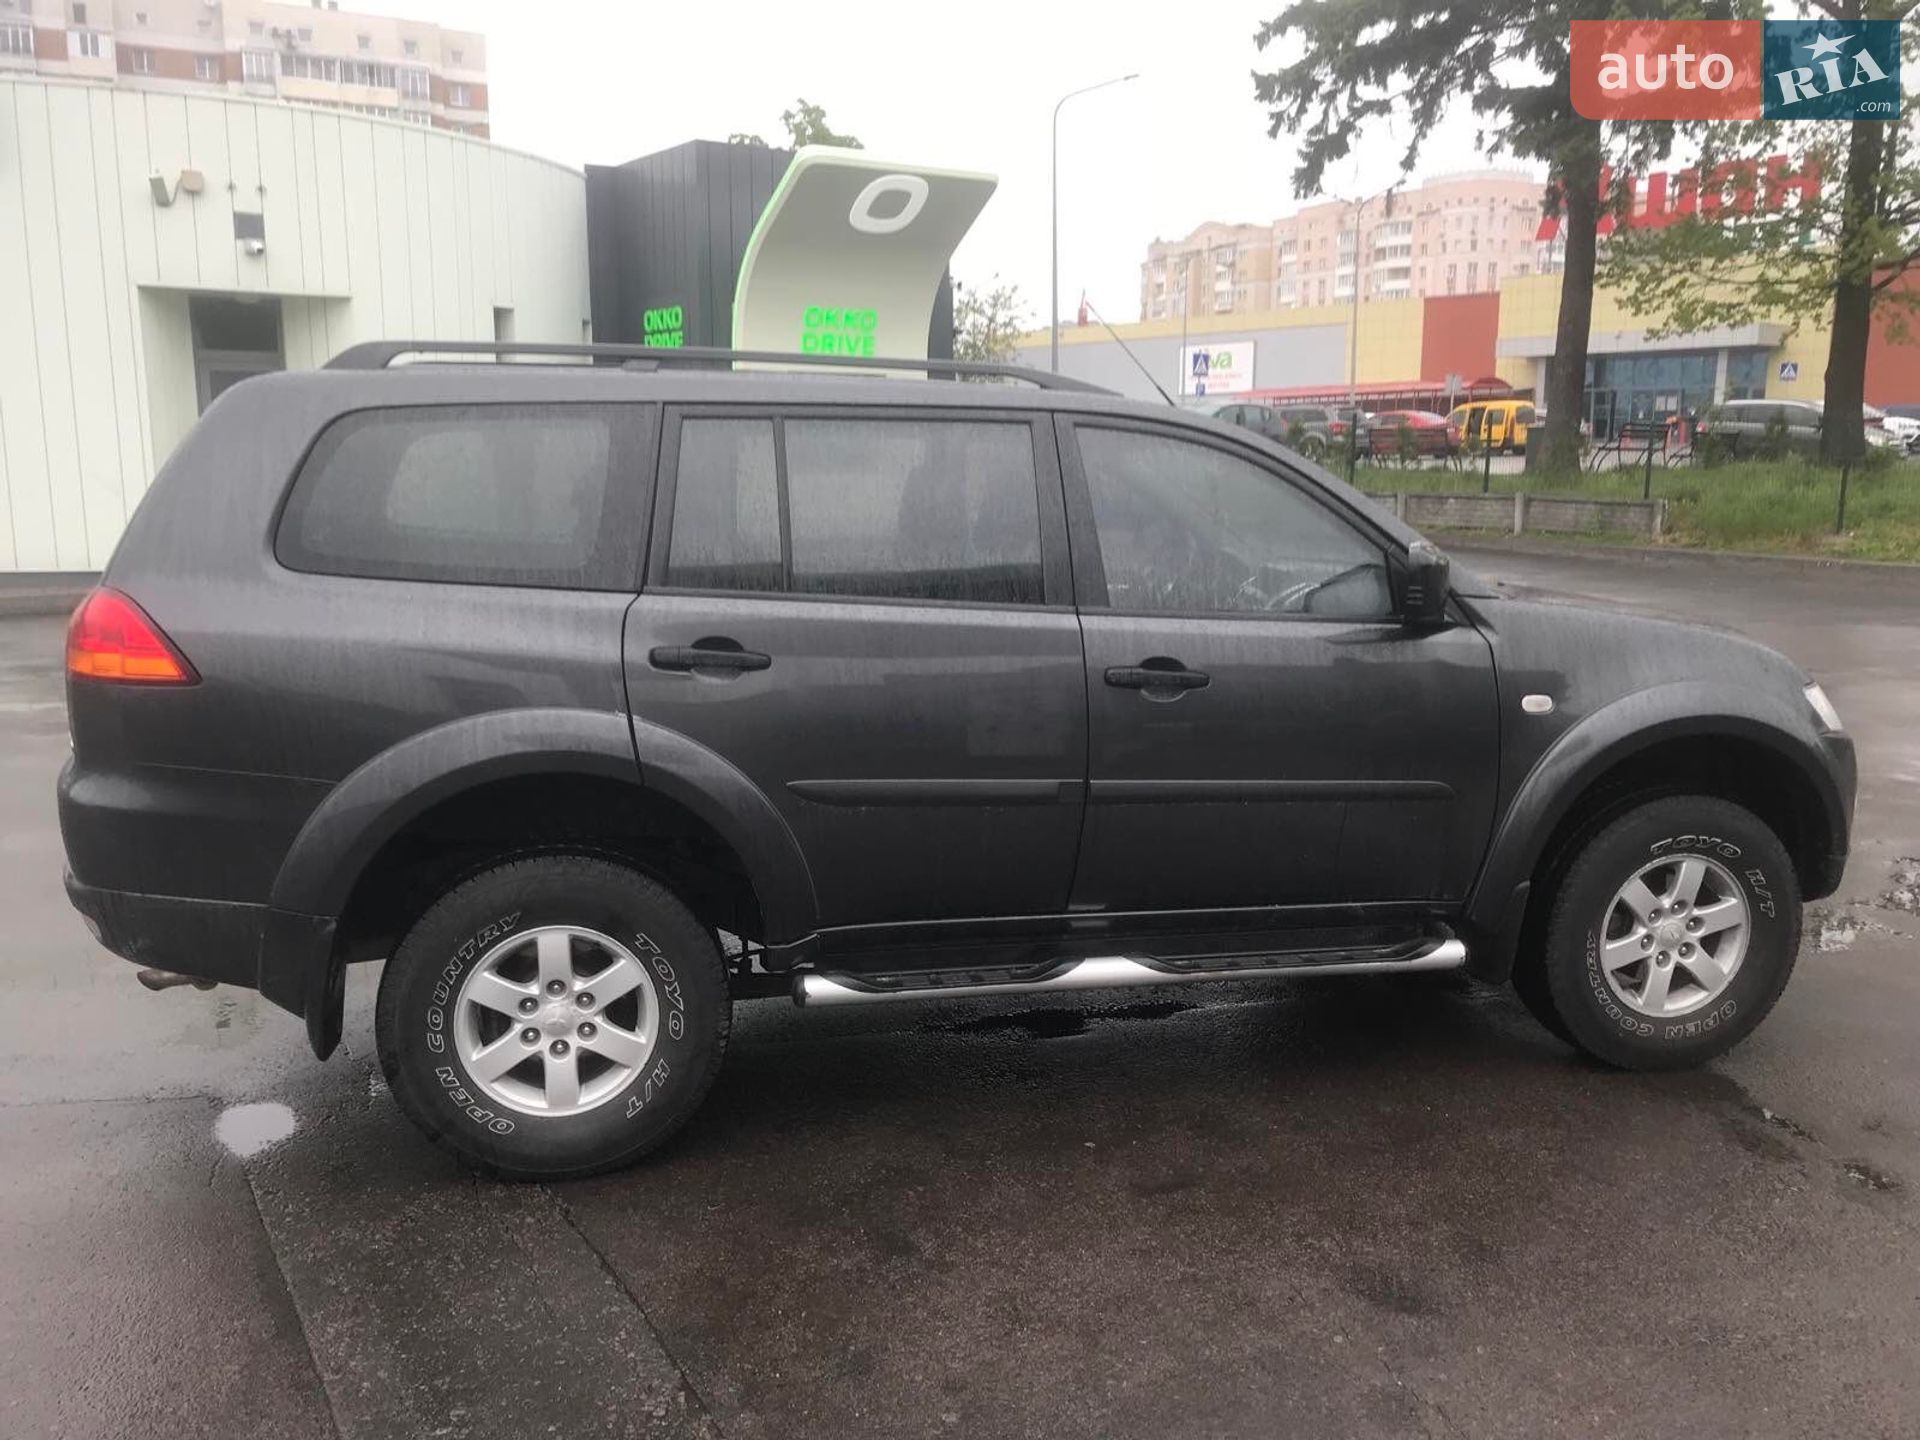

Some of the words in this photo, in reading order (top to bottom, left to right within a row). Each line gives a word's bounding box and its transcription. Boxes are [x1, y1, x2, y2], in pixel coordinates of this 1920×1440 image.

[643, 305, 683, 331] OKKO
[801, 332, 876, 358] DRIVE
[802, 305, 879, 332] OKKO
[1650, 834, 1742, 859] TOYO
[1745, 868, 1775, 918] H/T
[427, 911, 521, 1053] COUNTRY
[633, 932, 684, 1040] TOYO
[1586, 930, 1655, 1037] COUNTRY
[1665, 1000, 1737, 1040] OPEN
[435, 1066, 515, 1135] OPEN
[626, 1058, 671, 1119] H/T
